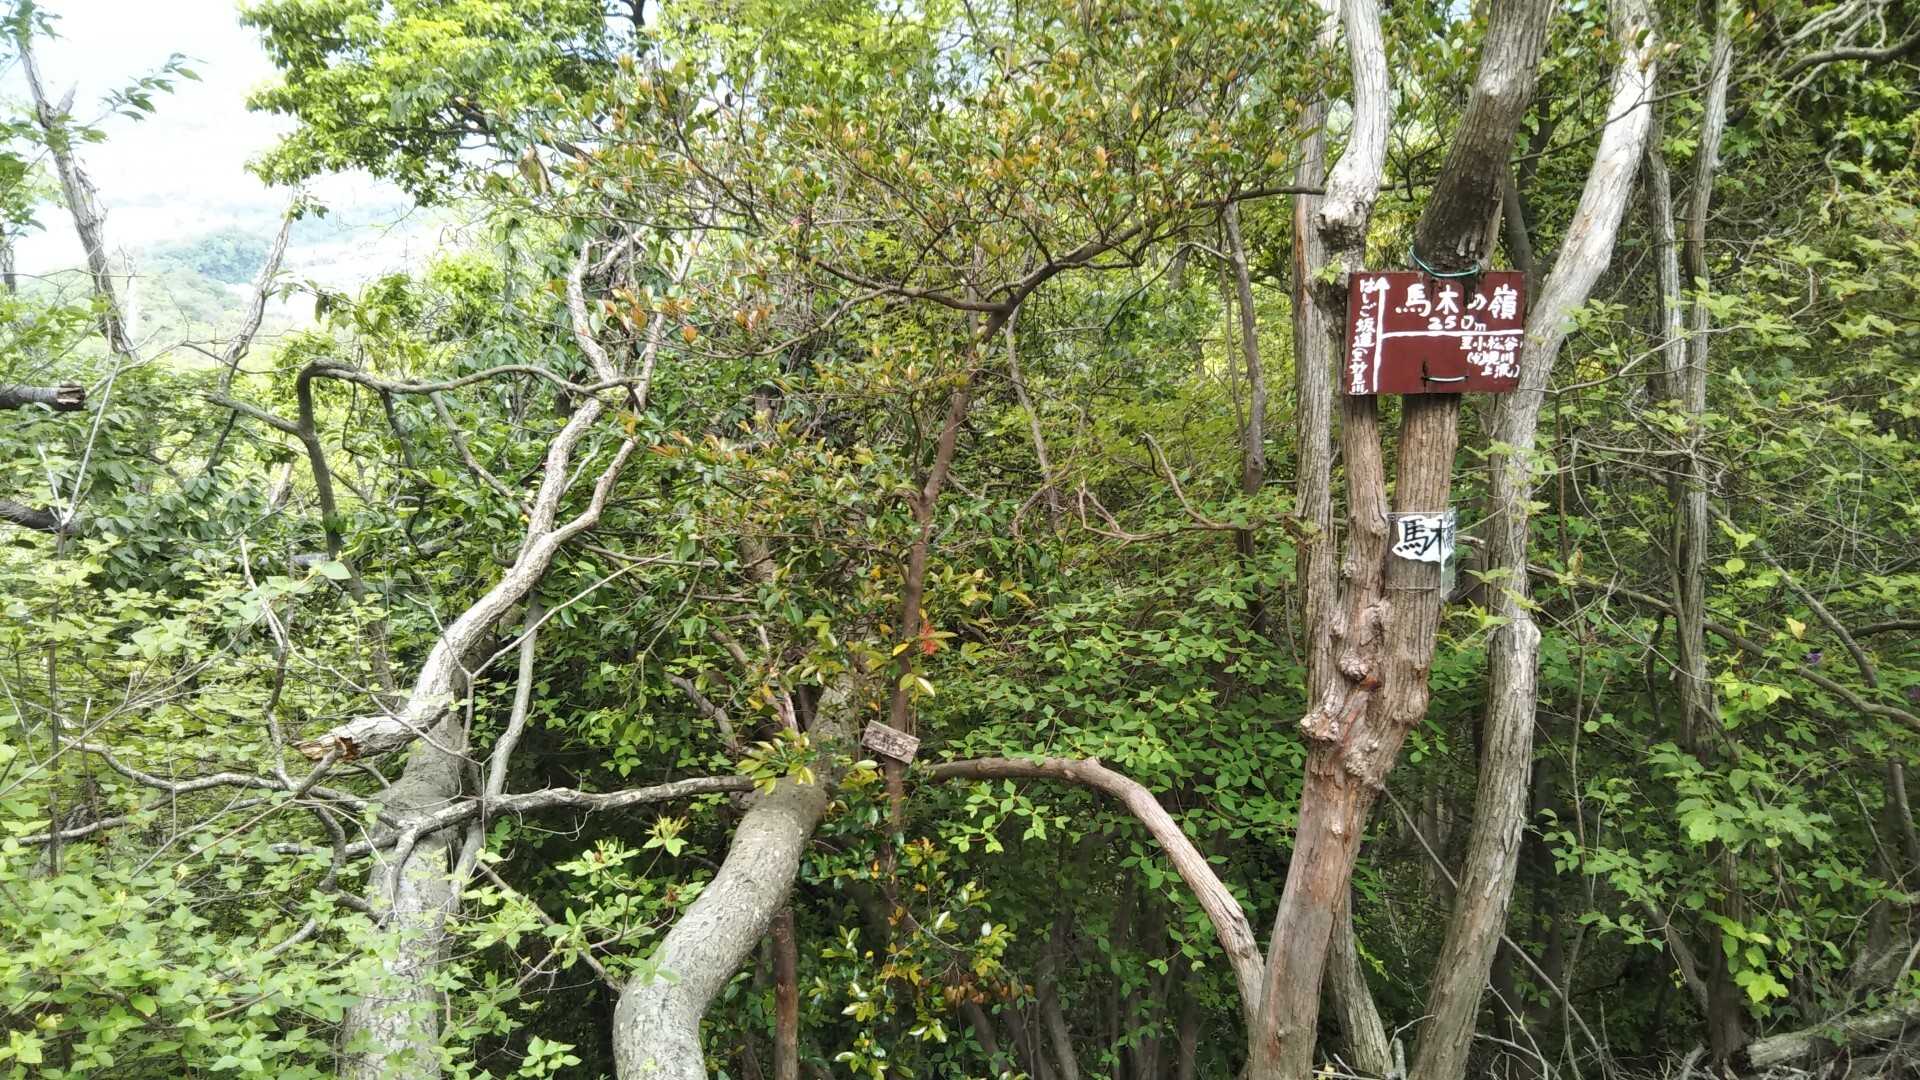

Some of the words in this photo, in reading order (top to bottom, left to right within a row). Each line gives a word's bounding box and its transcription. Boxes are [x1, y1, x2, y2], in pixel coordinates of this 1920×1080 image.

[1395, 283, 1518, 320] 馬木の嶺
[1427, 315, 1487, 332] 250m
